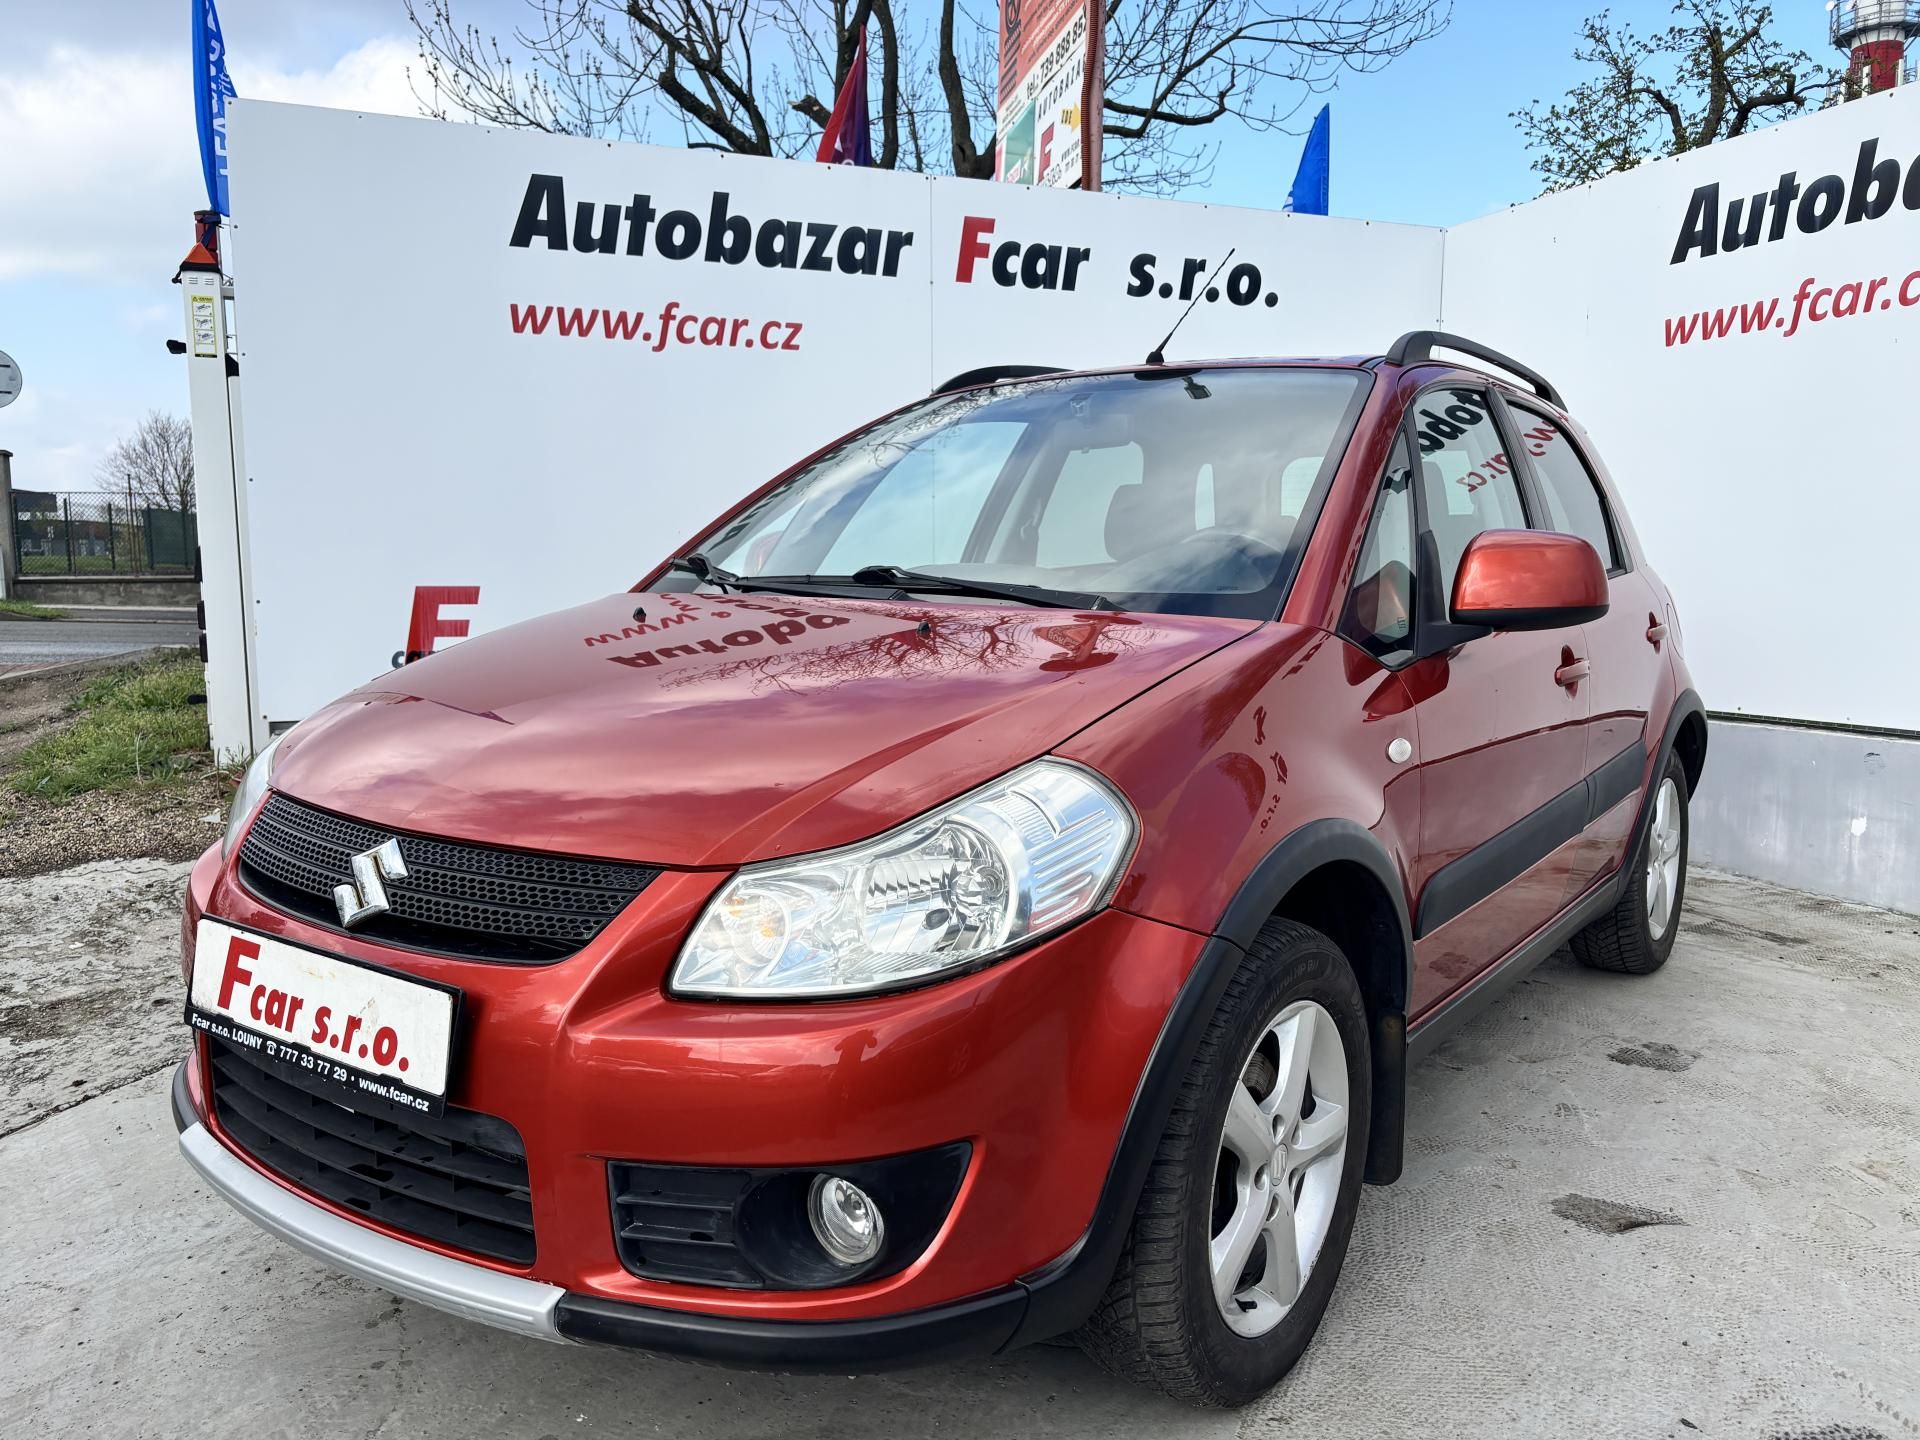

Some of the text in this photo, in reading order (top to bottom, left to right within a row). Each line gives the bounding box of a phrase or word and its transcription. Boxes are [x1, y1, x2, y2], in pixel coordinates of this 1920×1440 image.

[1040, 51, 1054, 83] 739
[1056, 30, 1070, 65] 888
[509, 173, 1279, 308] Autobazar Fcar s.r.o.
[509, 302, 803, 353] www.fcar.cz
[405, 585, 481, 666] F
[217, 935, 410, 1072] Fcar s.r.o.
[191, 1013, 430, 1113] Fcar s.r.o. LOUNY 777 33 77 29 www.fcar.cz
